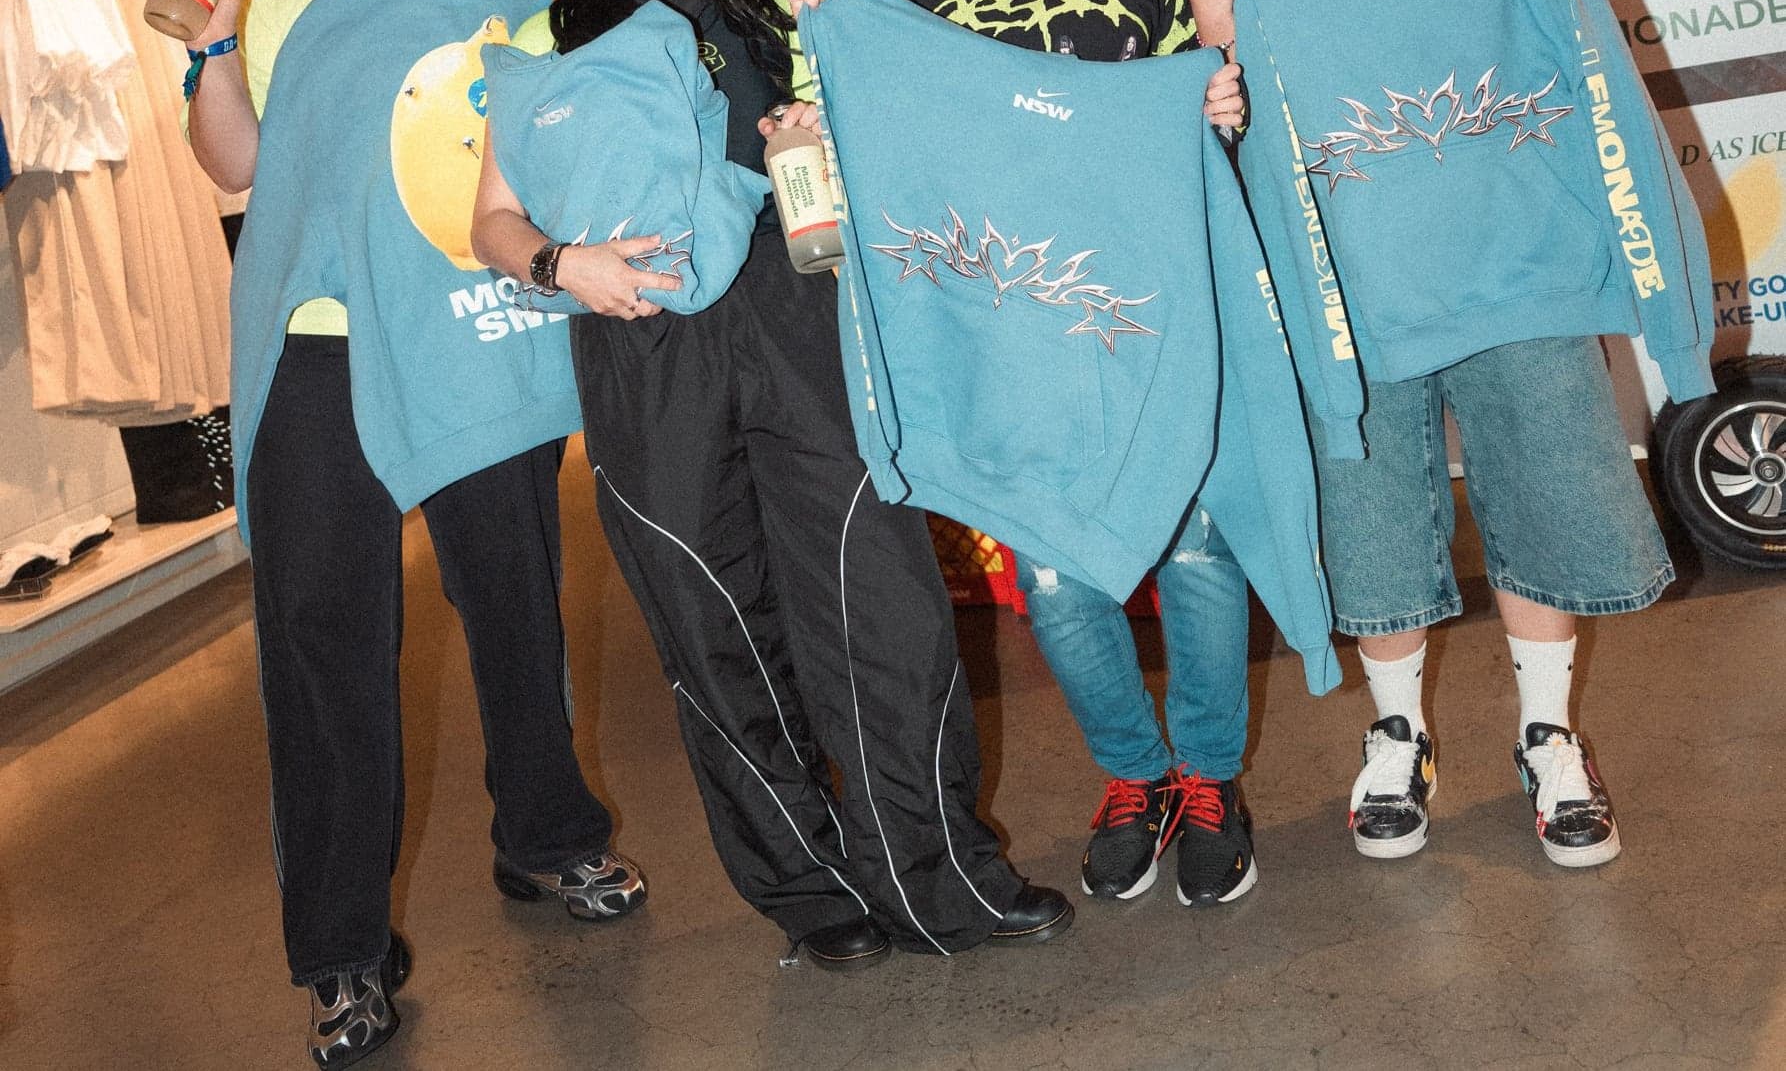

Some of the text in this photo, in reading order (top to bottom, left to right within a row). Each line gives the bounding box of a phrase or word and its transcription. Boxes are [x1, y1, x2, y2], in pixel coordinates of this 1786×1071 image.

[533, 104, 575, 129] NSW
[1012, 93, 1074, 122] NSW
[1706, 136, 1744, 164] AS
[781, 163, 800, 219] Lemonade
[793, 166, 810, 210] Lemons
[800, 165, 816, 206] Making
[1711, 279, 1742, 302] TY
